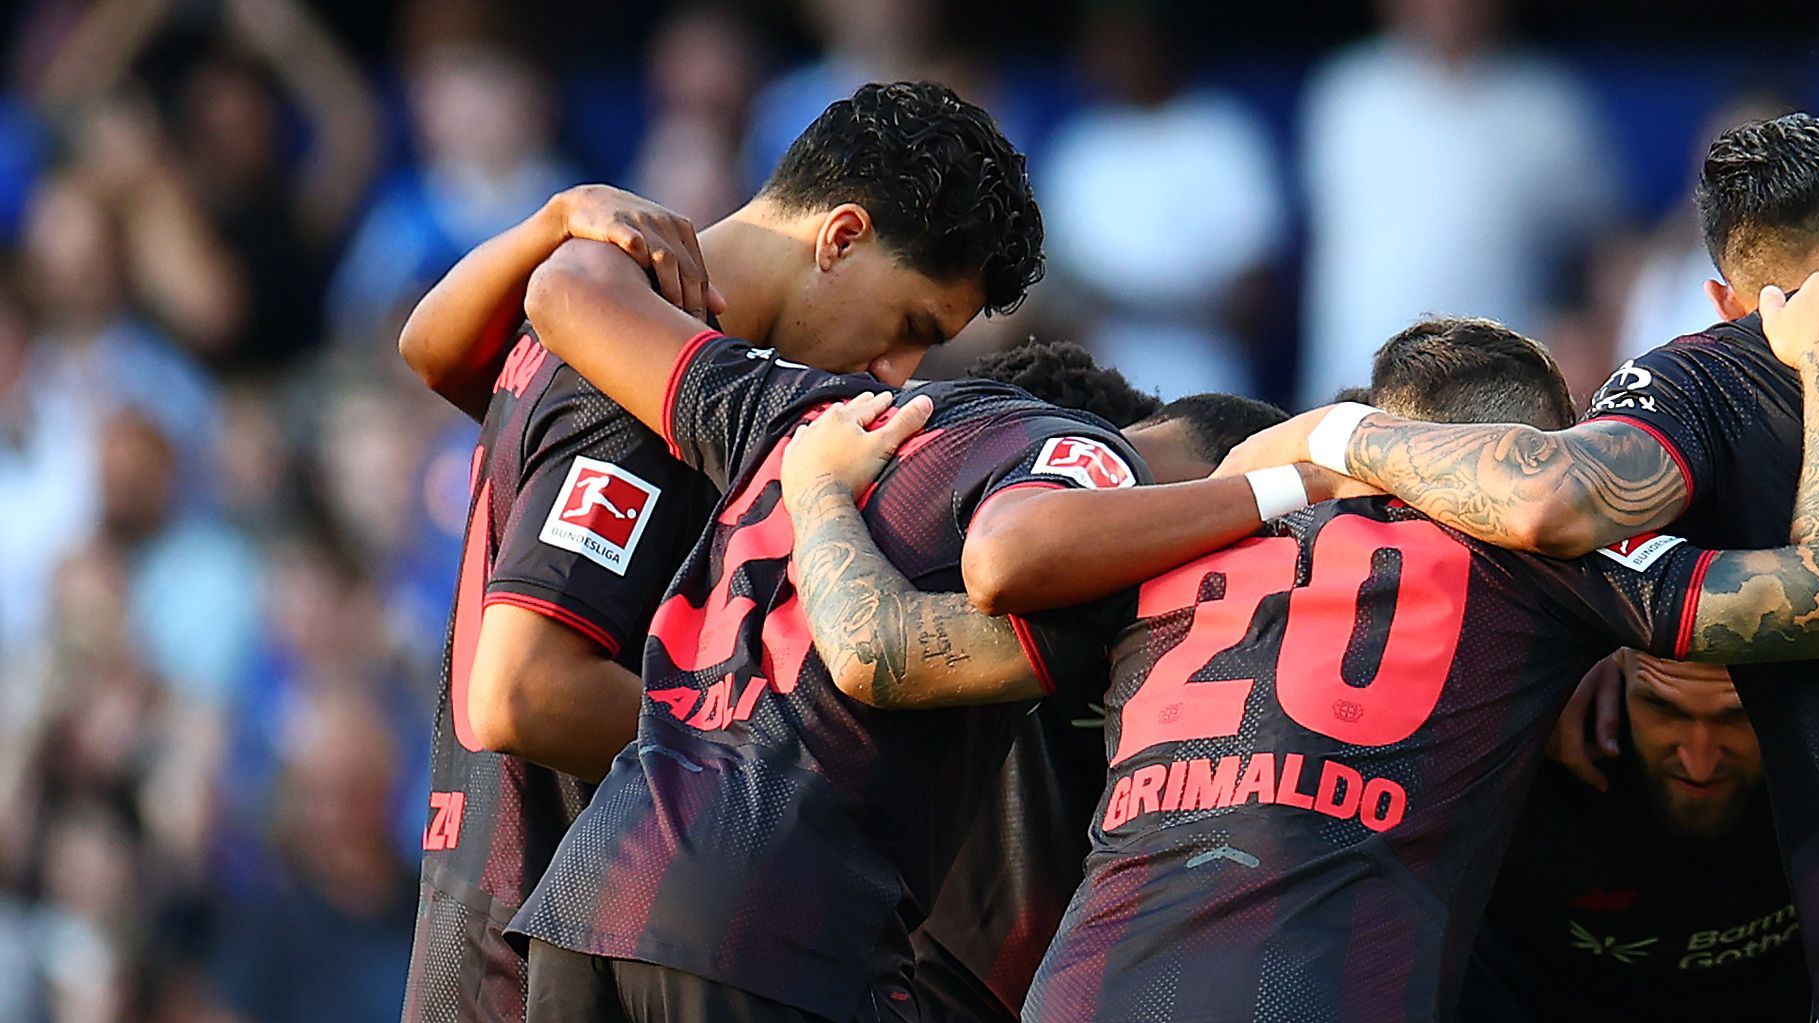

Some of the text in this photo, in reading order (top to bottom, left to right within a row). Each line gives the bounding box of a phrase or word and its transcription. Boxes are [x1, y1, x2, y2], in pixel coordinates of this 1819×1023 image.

[551, 527, 621, 564] BUNDESLIGA
[1109, 514, 1471, 767] 20
[647, 672, 768, 731] ADLI
[422, 791, 466, 850] ZA
[1103, 753, 1407, 832] GRIMALDO
[1678, 922, 1799, 970] Goth
[1687, 904, 1796, 950] Barm
